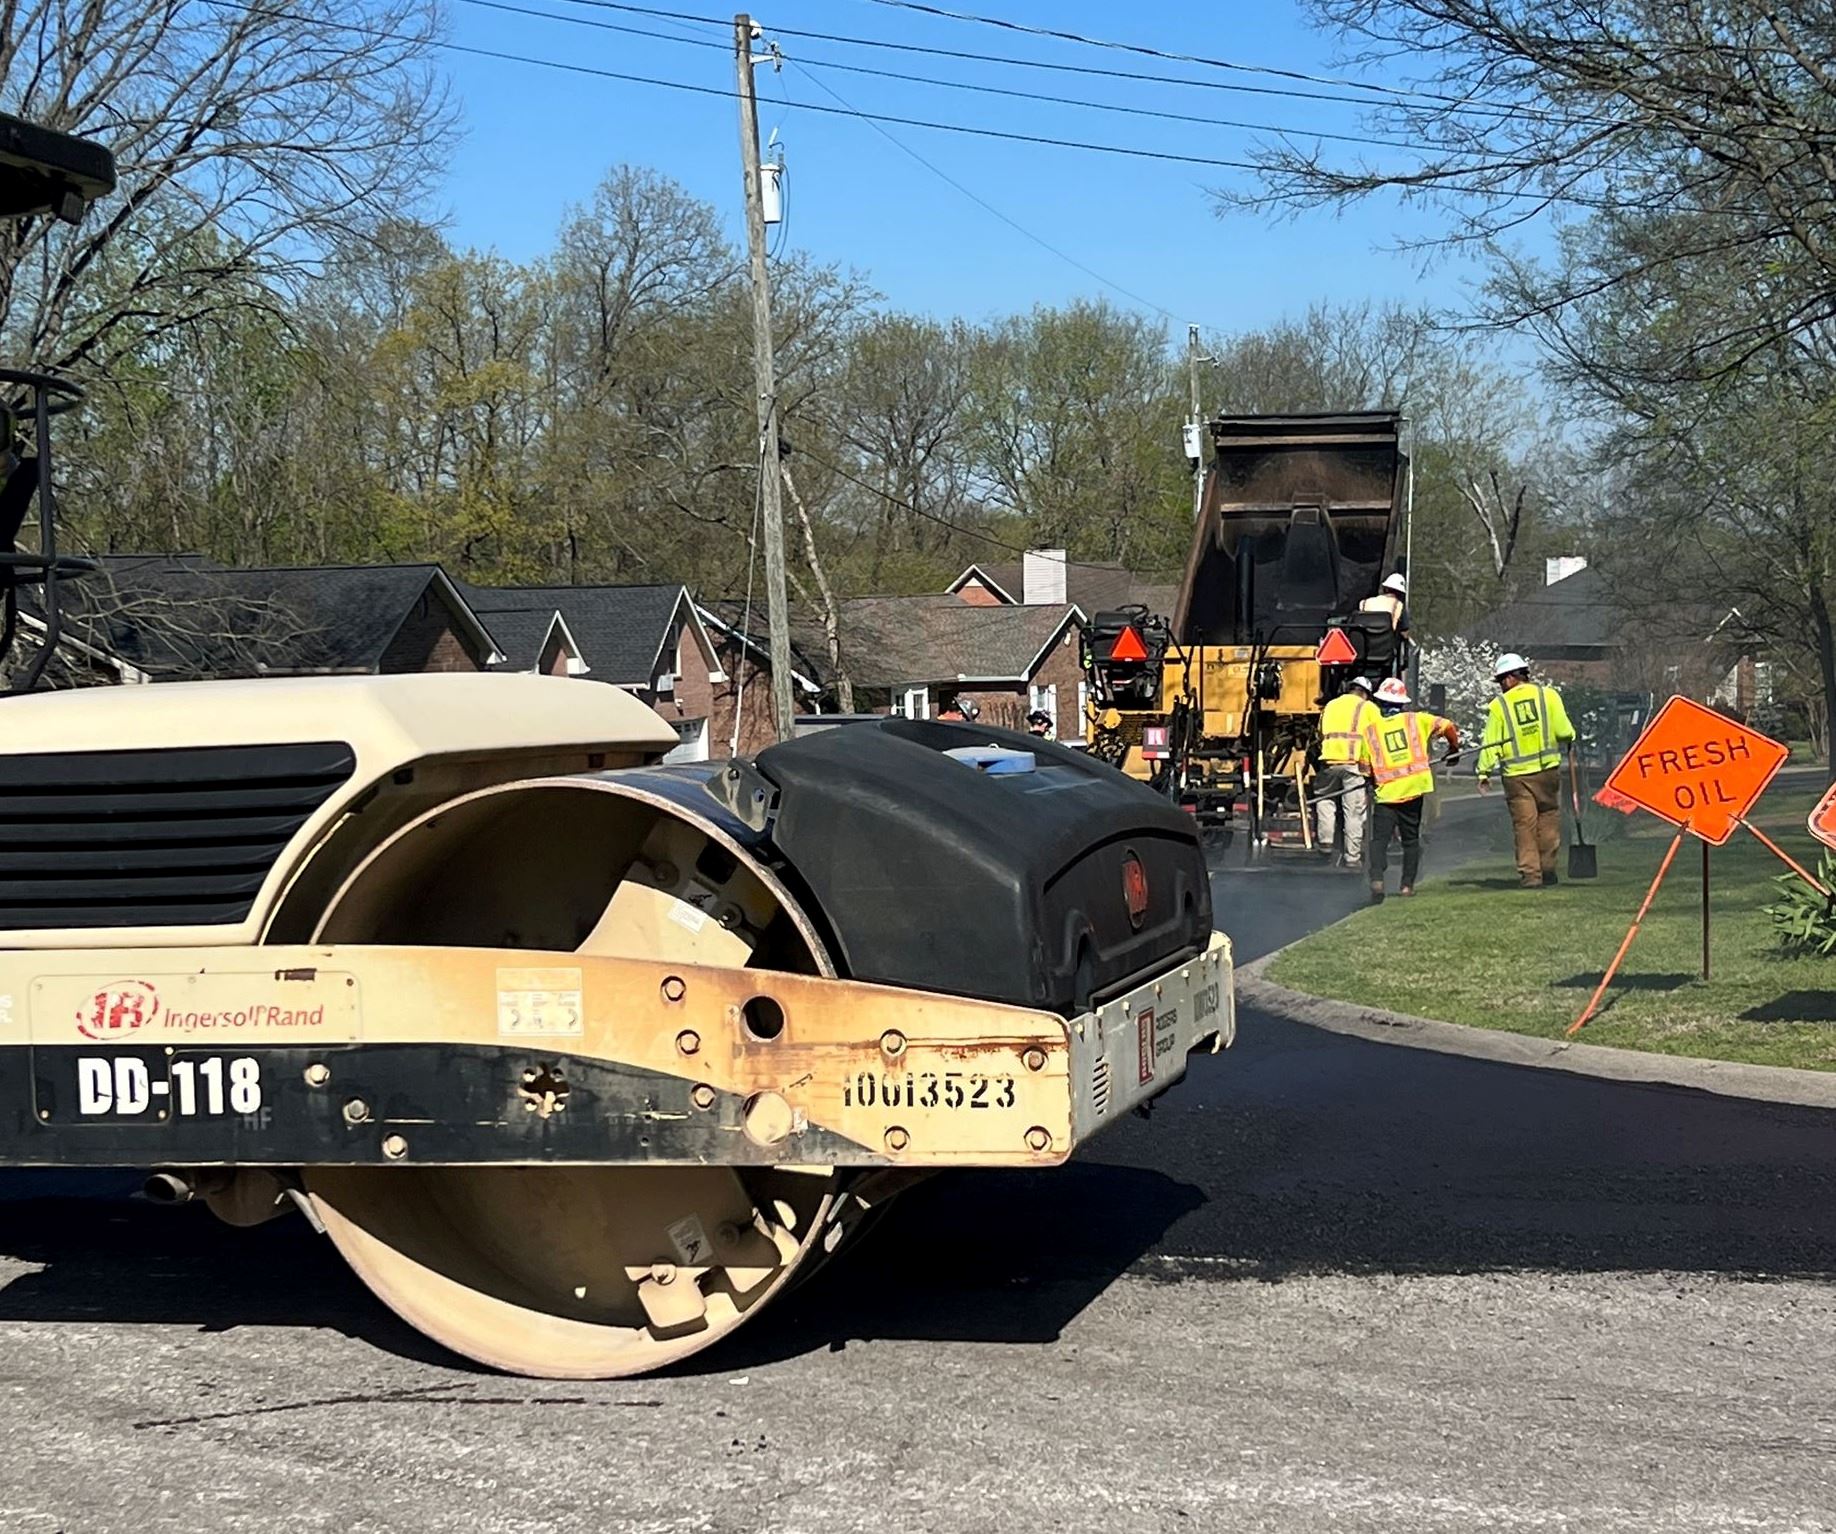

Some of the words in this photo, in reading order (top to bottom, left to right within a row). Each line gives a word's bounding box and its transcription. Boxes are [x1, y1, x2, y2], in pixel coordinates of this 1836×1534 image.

[1636, 735, 1750, 778] FRESH
[1674, 779, 1737, 809] OIL
[78, 1057, 262, 1115] DD-118
[843, 1072, 1015, 1108] 10013523
